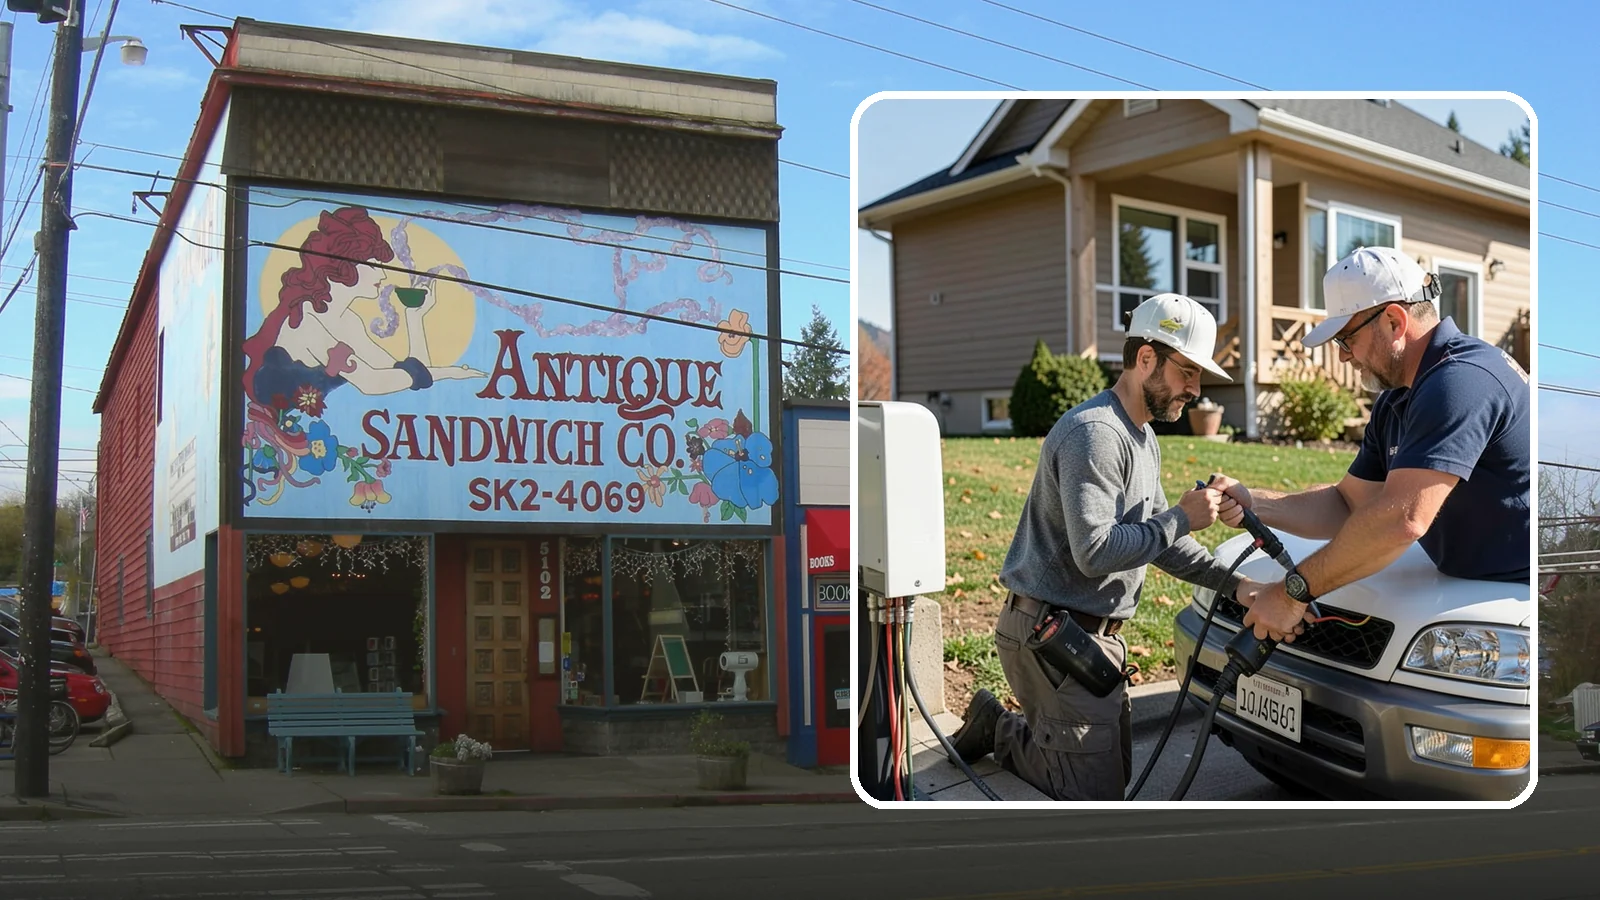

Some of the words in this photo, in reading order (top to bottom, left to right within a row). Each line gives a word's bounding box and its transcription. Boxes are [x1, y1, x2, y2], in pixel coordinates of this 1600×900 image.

[476, 329, 723, 420] ANTIQUE
[361, 409, 605, 467] SANDWICH
[617, 422, 686, 469] CO.
[468, 477, 646, 513] SK2-4069
[540, 541, 551, 600] 5102
[809, 555, 835, 569] BOOKS
